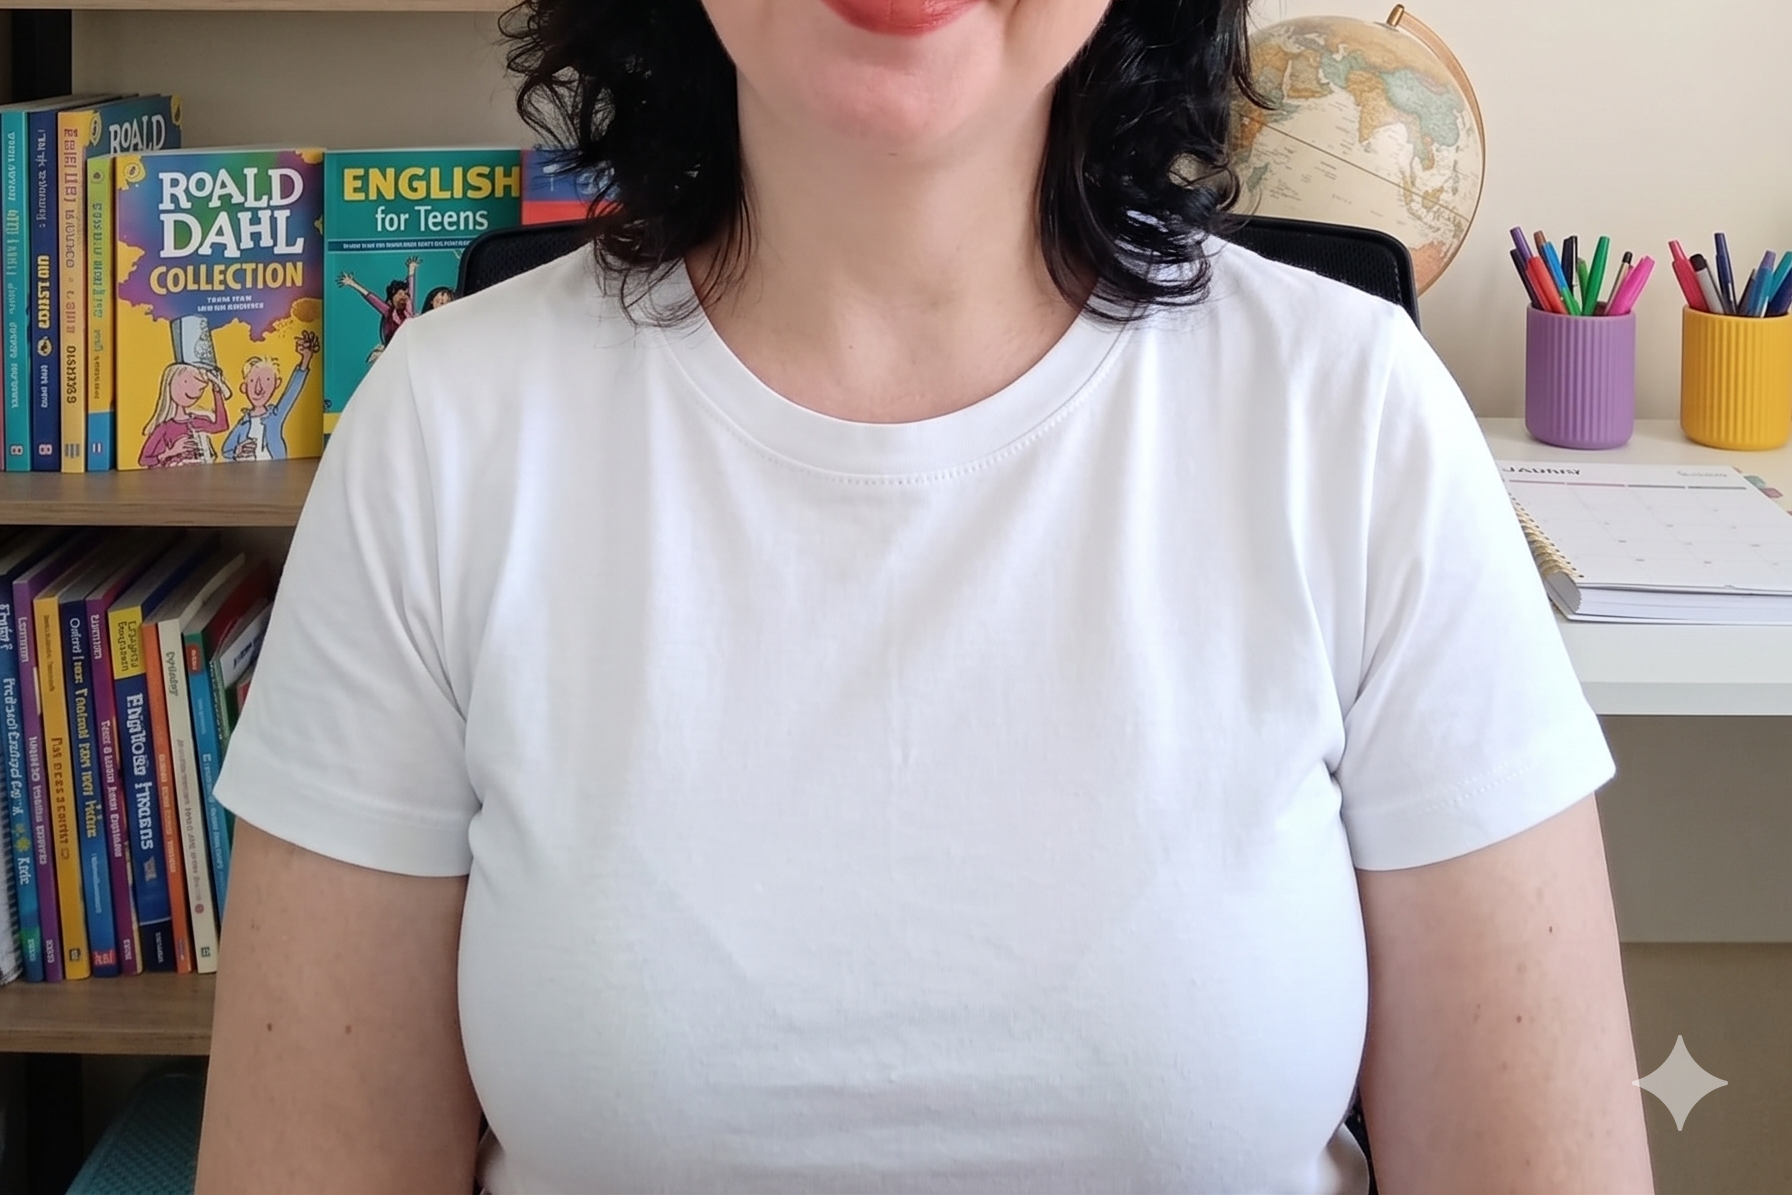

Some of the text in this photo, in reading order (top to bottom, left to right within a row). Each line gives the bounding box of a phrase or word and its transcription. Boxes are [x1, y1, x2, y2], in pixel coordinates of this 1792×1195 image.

[109, 114, 166, 155] ROALD
[158, 167, 304, 210] ROALD
[342, 166, 520, 202] ENGLISH
[159, 208, 305, 259] DAHL
[375, 205, 489, 232] for Teens
[149, 260, 304, 296] COLLECTION
